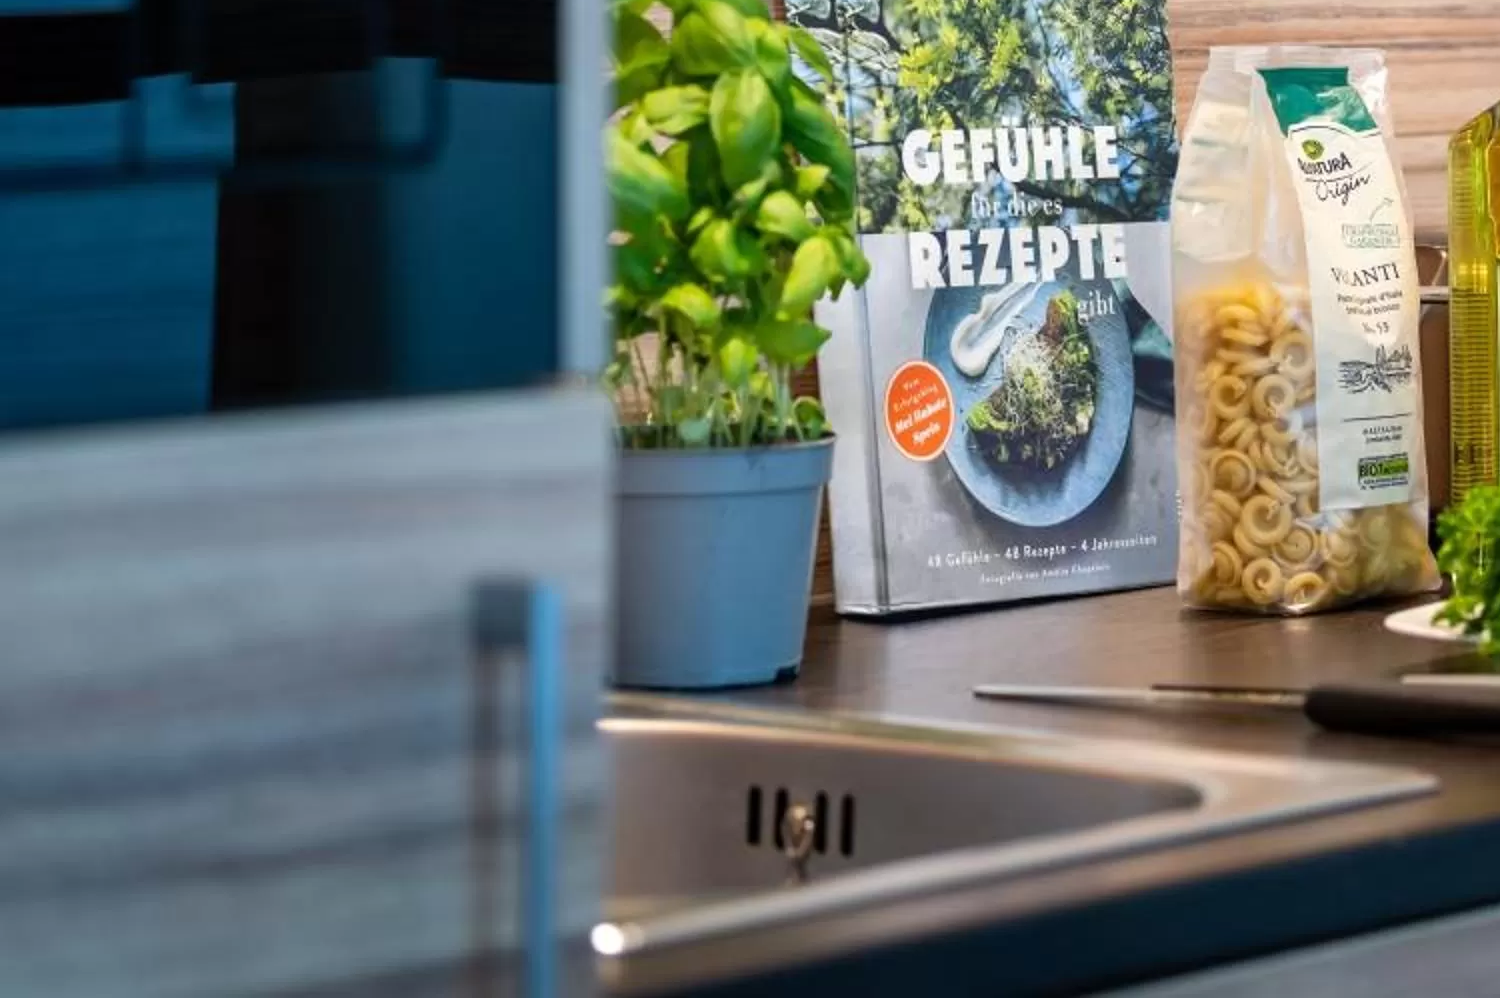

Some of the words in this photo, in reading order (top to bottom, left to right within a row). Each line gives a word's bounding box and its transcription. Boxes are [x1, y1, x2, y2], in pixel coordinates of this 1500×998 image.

[902, 117, 1119, 185] GEFÜHLE
[1008, 189, 1039, 217] die
[1043, 198, 1063, 216] es
[909, 224, 1128, 289] REZEPTE
[1077, 290, 1116, 326] gibt
[1023, 543, 1067, 562] Rezepte
